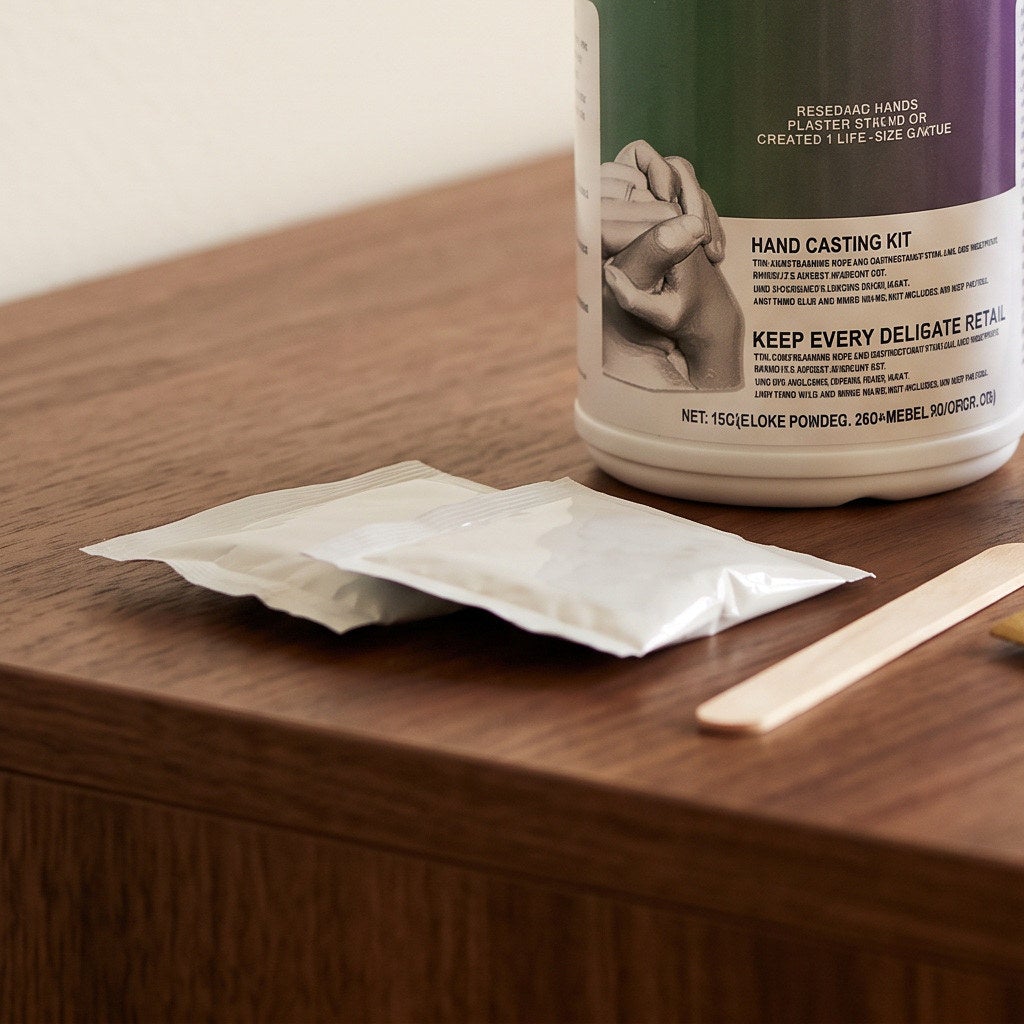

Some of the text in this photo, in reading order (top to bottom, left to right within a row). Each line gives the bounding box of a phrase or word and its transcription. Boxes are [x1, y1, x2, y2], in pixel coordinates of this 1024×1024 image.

[875, 99, 918, 113] HANDS
[787, 119, 850, 131] PLASTER
[909, 112, 927, 125] OR
[757, 133, 822, 145] CREATED
[826, 133, 832, 144] 1
[751, 237, 801, 254] HAND
[805, 234, 882, 254] CASTING
[887, 231, 912, 249] KIT
[753, 331, 805, 348] KEEP
[810, 328, 875, 348] EVERY
[965, 305, 1006, 331] RETAIL
[682, 408, 708, 424] NET:
